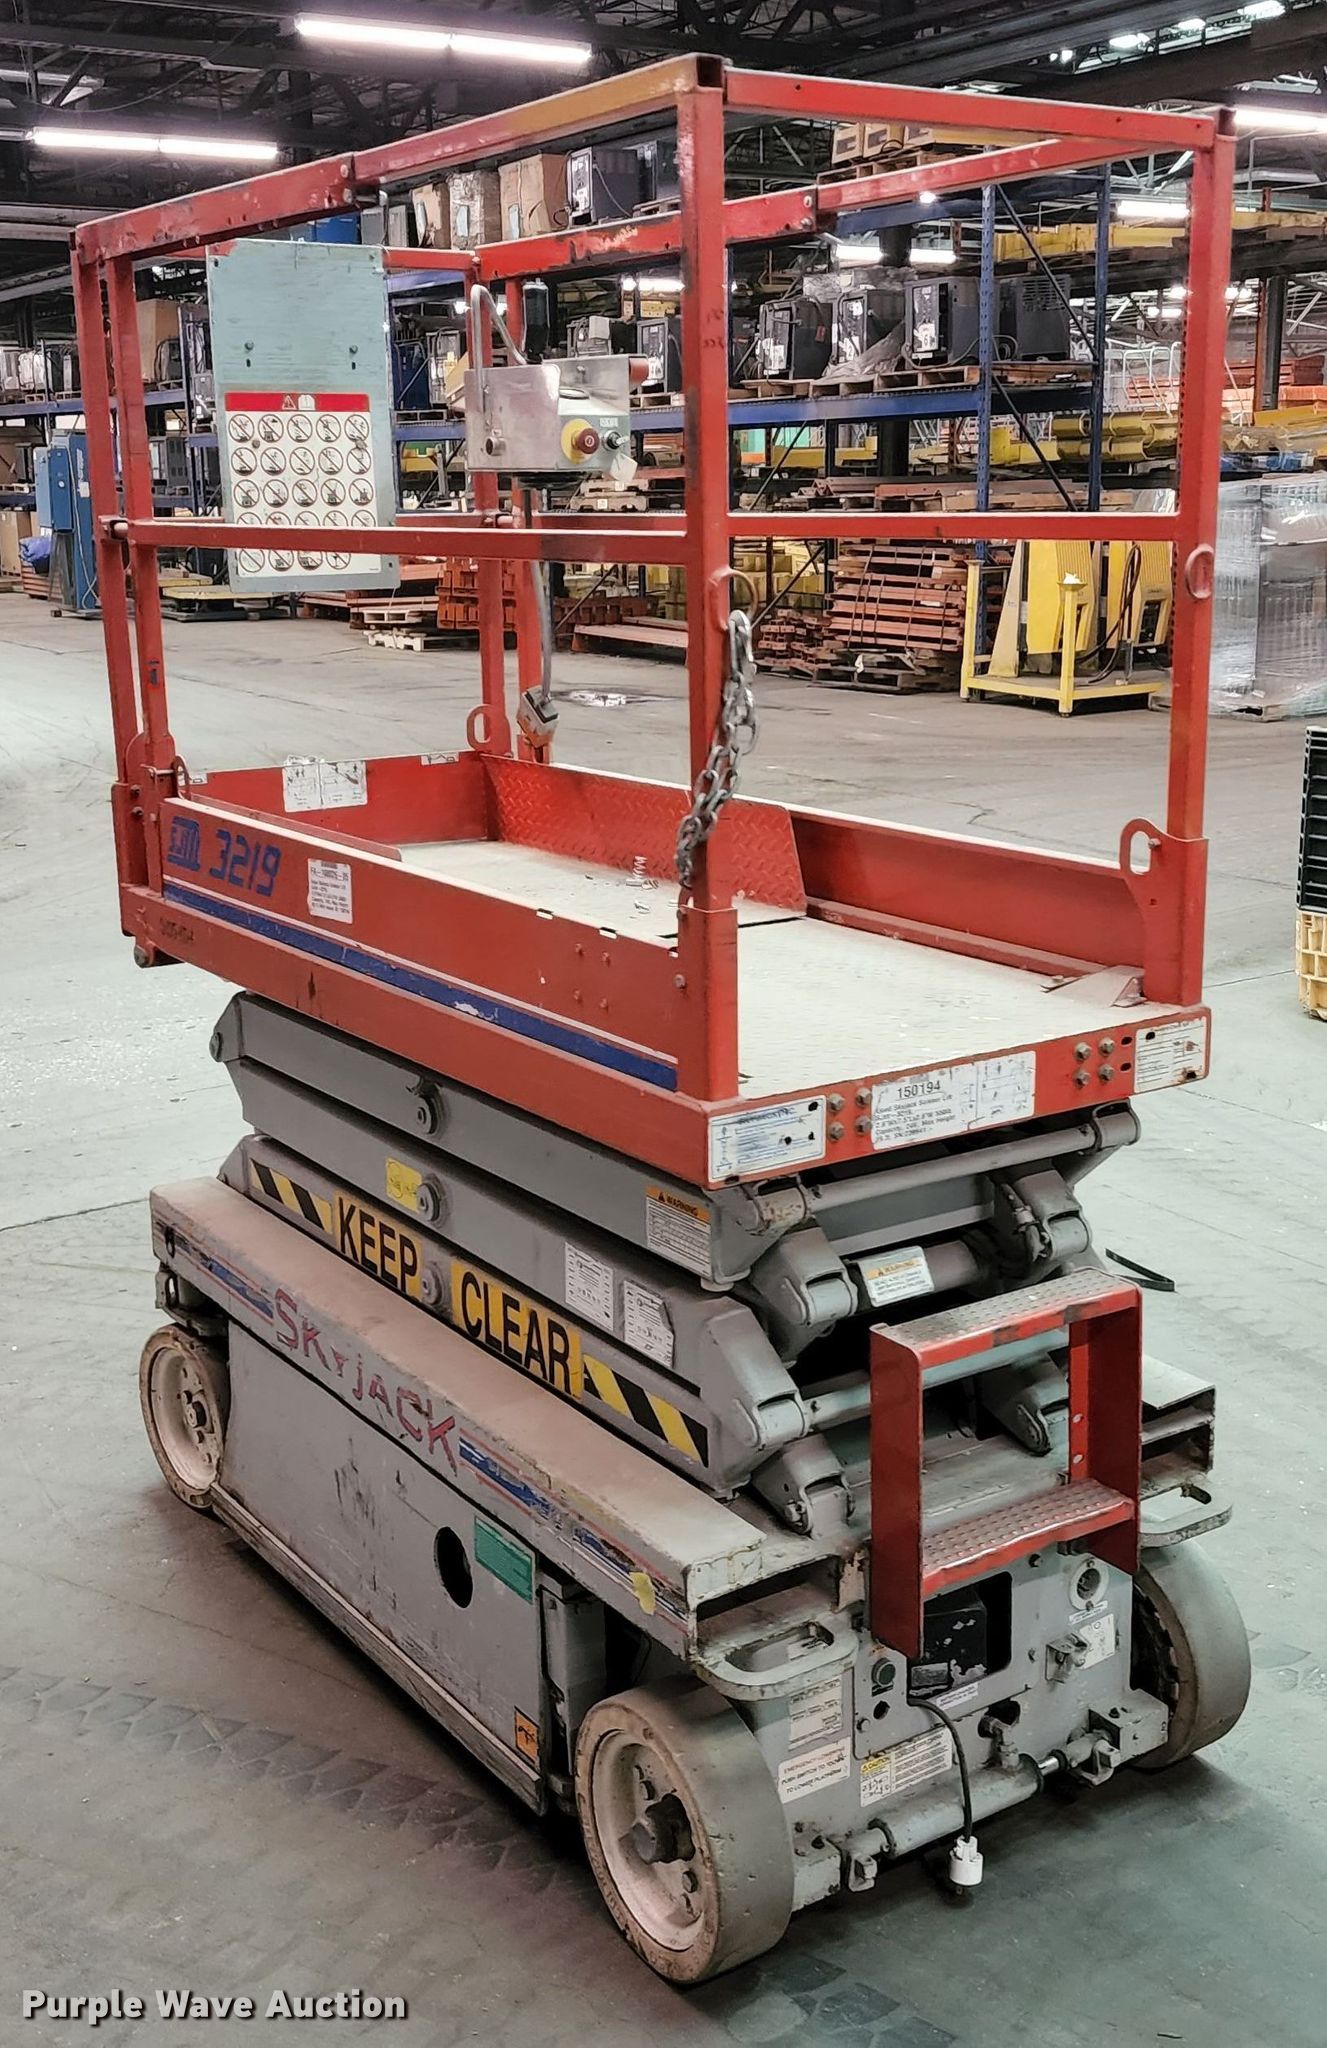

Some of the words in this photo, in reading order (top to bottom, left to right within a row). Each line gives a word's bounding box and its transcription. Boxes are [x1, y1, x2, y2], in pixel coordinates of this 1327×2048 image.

[209, 828, 282, 897] 3219
[898, 1080, 942, 1099] 150194
[338, 1196, 418, 1295] KEEP
[461, 1271, 572, 1395] CLEAR
